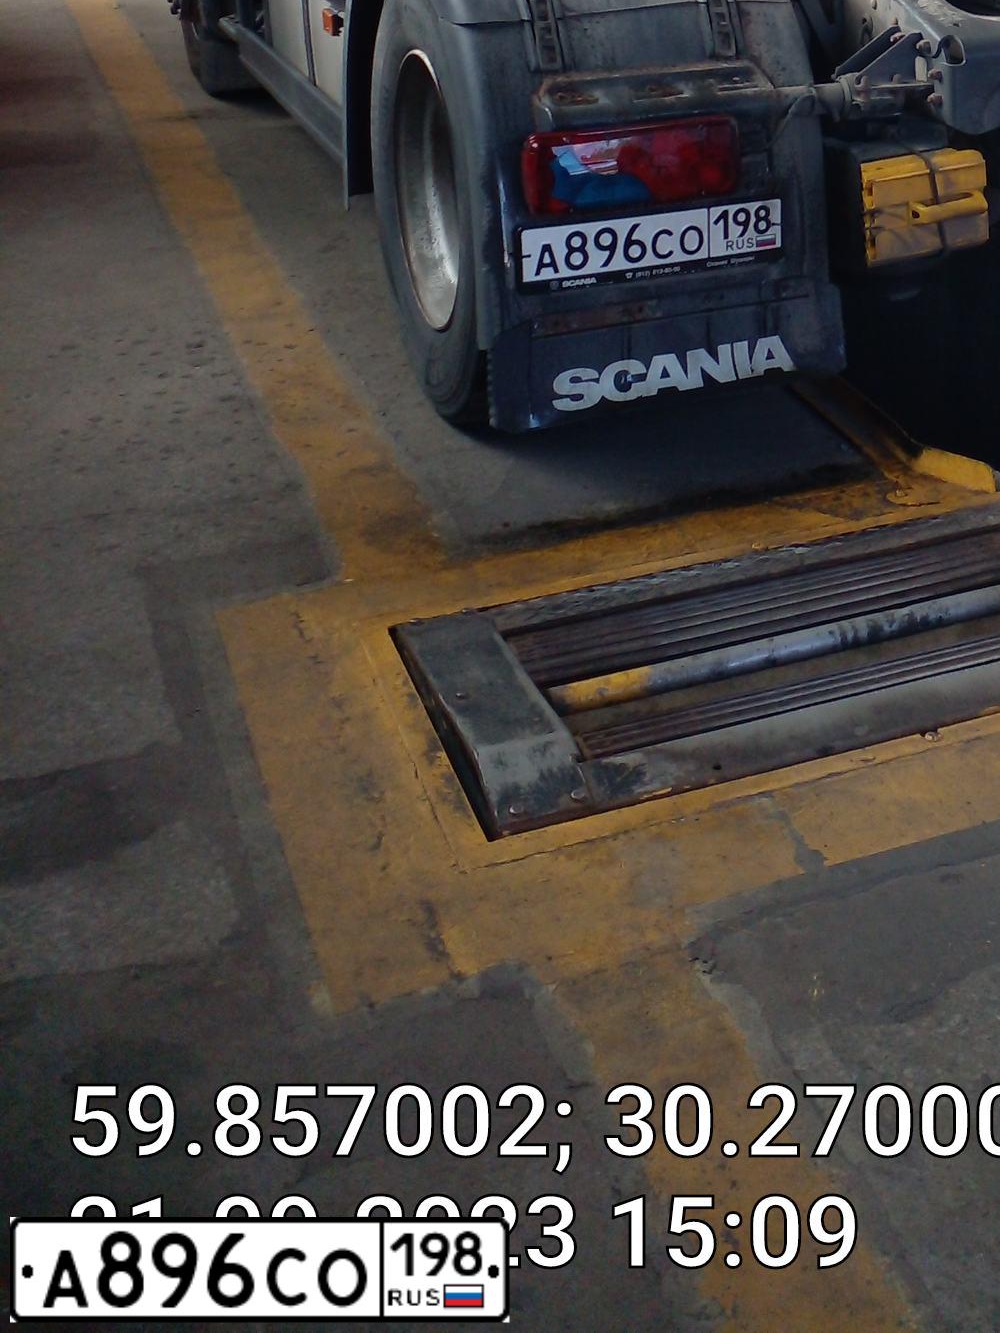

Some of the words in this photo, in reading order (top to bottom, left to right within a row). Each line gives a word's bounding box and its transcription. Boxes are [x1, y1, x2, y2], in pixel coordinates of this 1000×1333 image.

[712, 205, 773, 239] 198
[725, 237, 755, 252] RUS
[562, 276, 598, 289] SCANIA
[552, 334, 797, 412] SCANIA
